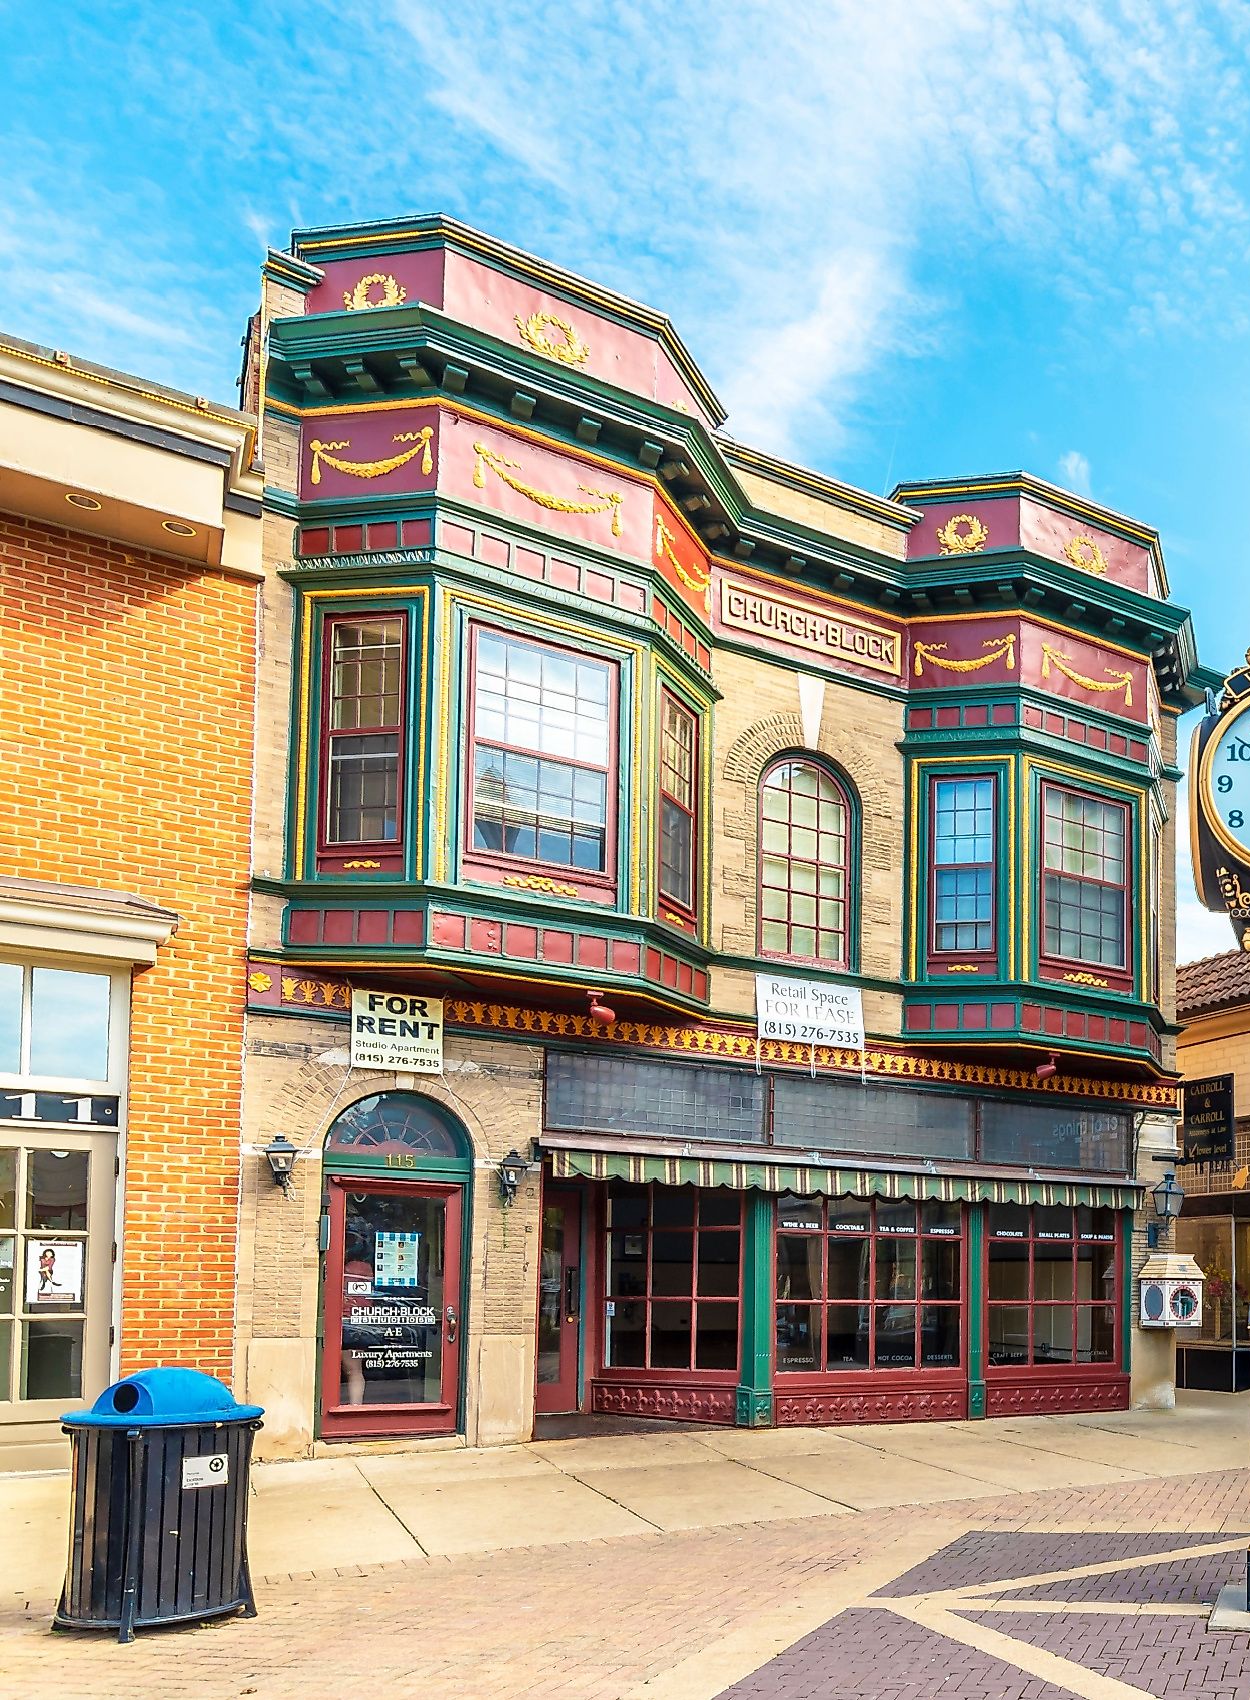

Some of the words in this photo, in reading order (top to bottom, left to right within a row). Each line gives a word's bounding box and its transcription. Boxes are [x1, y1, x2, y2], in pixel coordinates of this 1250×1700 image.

[1217, 775, 1233, 793] 9
[1227, 810, 1244, 828] 8
[771, 982, 806, 1000] Retail
[811, 988, 849, 1006] Space
[368, 994, 429, 1017] FOR
[765, 999, 800, 1018] FOR
[806, 1004, 856, 1025] LEASE
[356, 1015, 440, 1040] RENT
[764, 1020, 797, 1038] (815)
[800, 1025, 859, 1044] 276-7535
[355, 1040, 387, 1050] Studio
[390, 1043, 440, 1055] Apartment
[355, 1052, 384, 1064] (815)
[388, 1055, 440, 1068] 276-7535
[1190, 1081, 1225, 1096] CARROLL
[1204, 1097, 1211, 1108] &
[1190, 1110, 1225, 1125] CARROLL
[387, 1153, 414, 1168] 115
[384, 1327, 403, 1337] A-E
[352, 1350, 384, 1360] Luxury
[384, 1350, 432, 1360] Apartments
[366, 1360, 384, 1369] (815)
[385, 1360, 418, 1368] 276-7535
